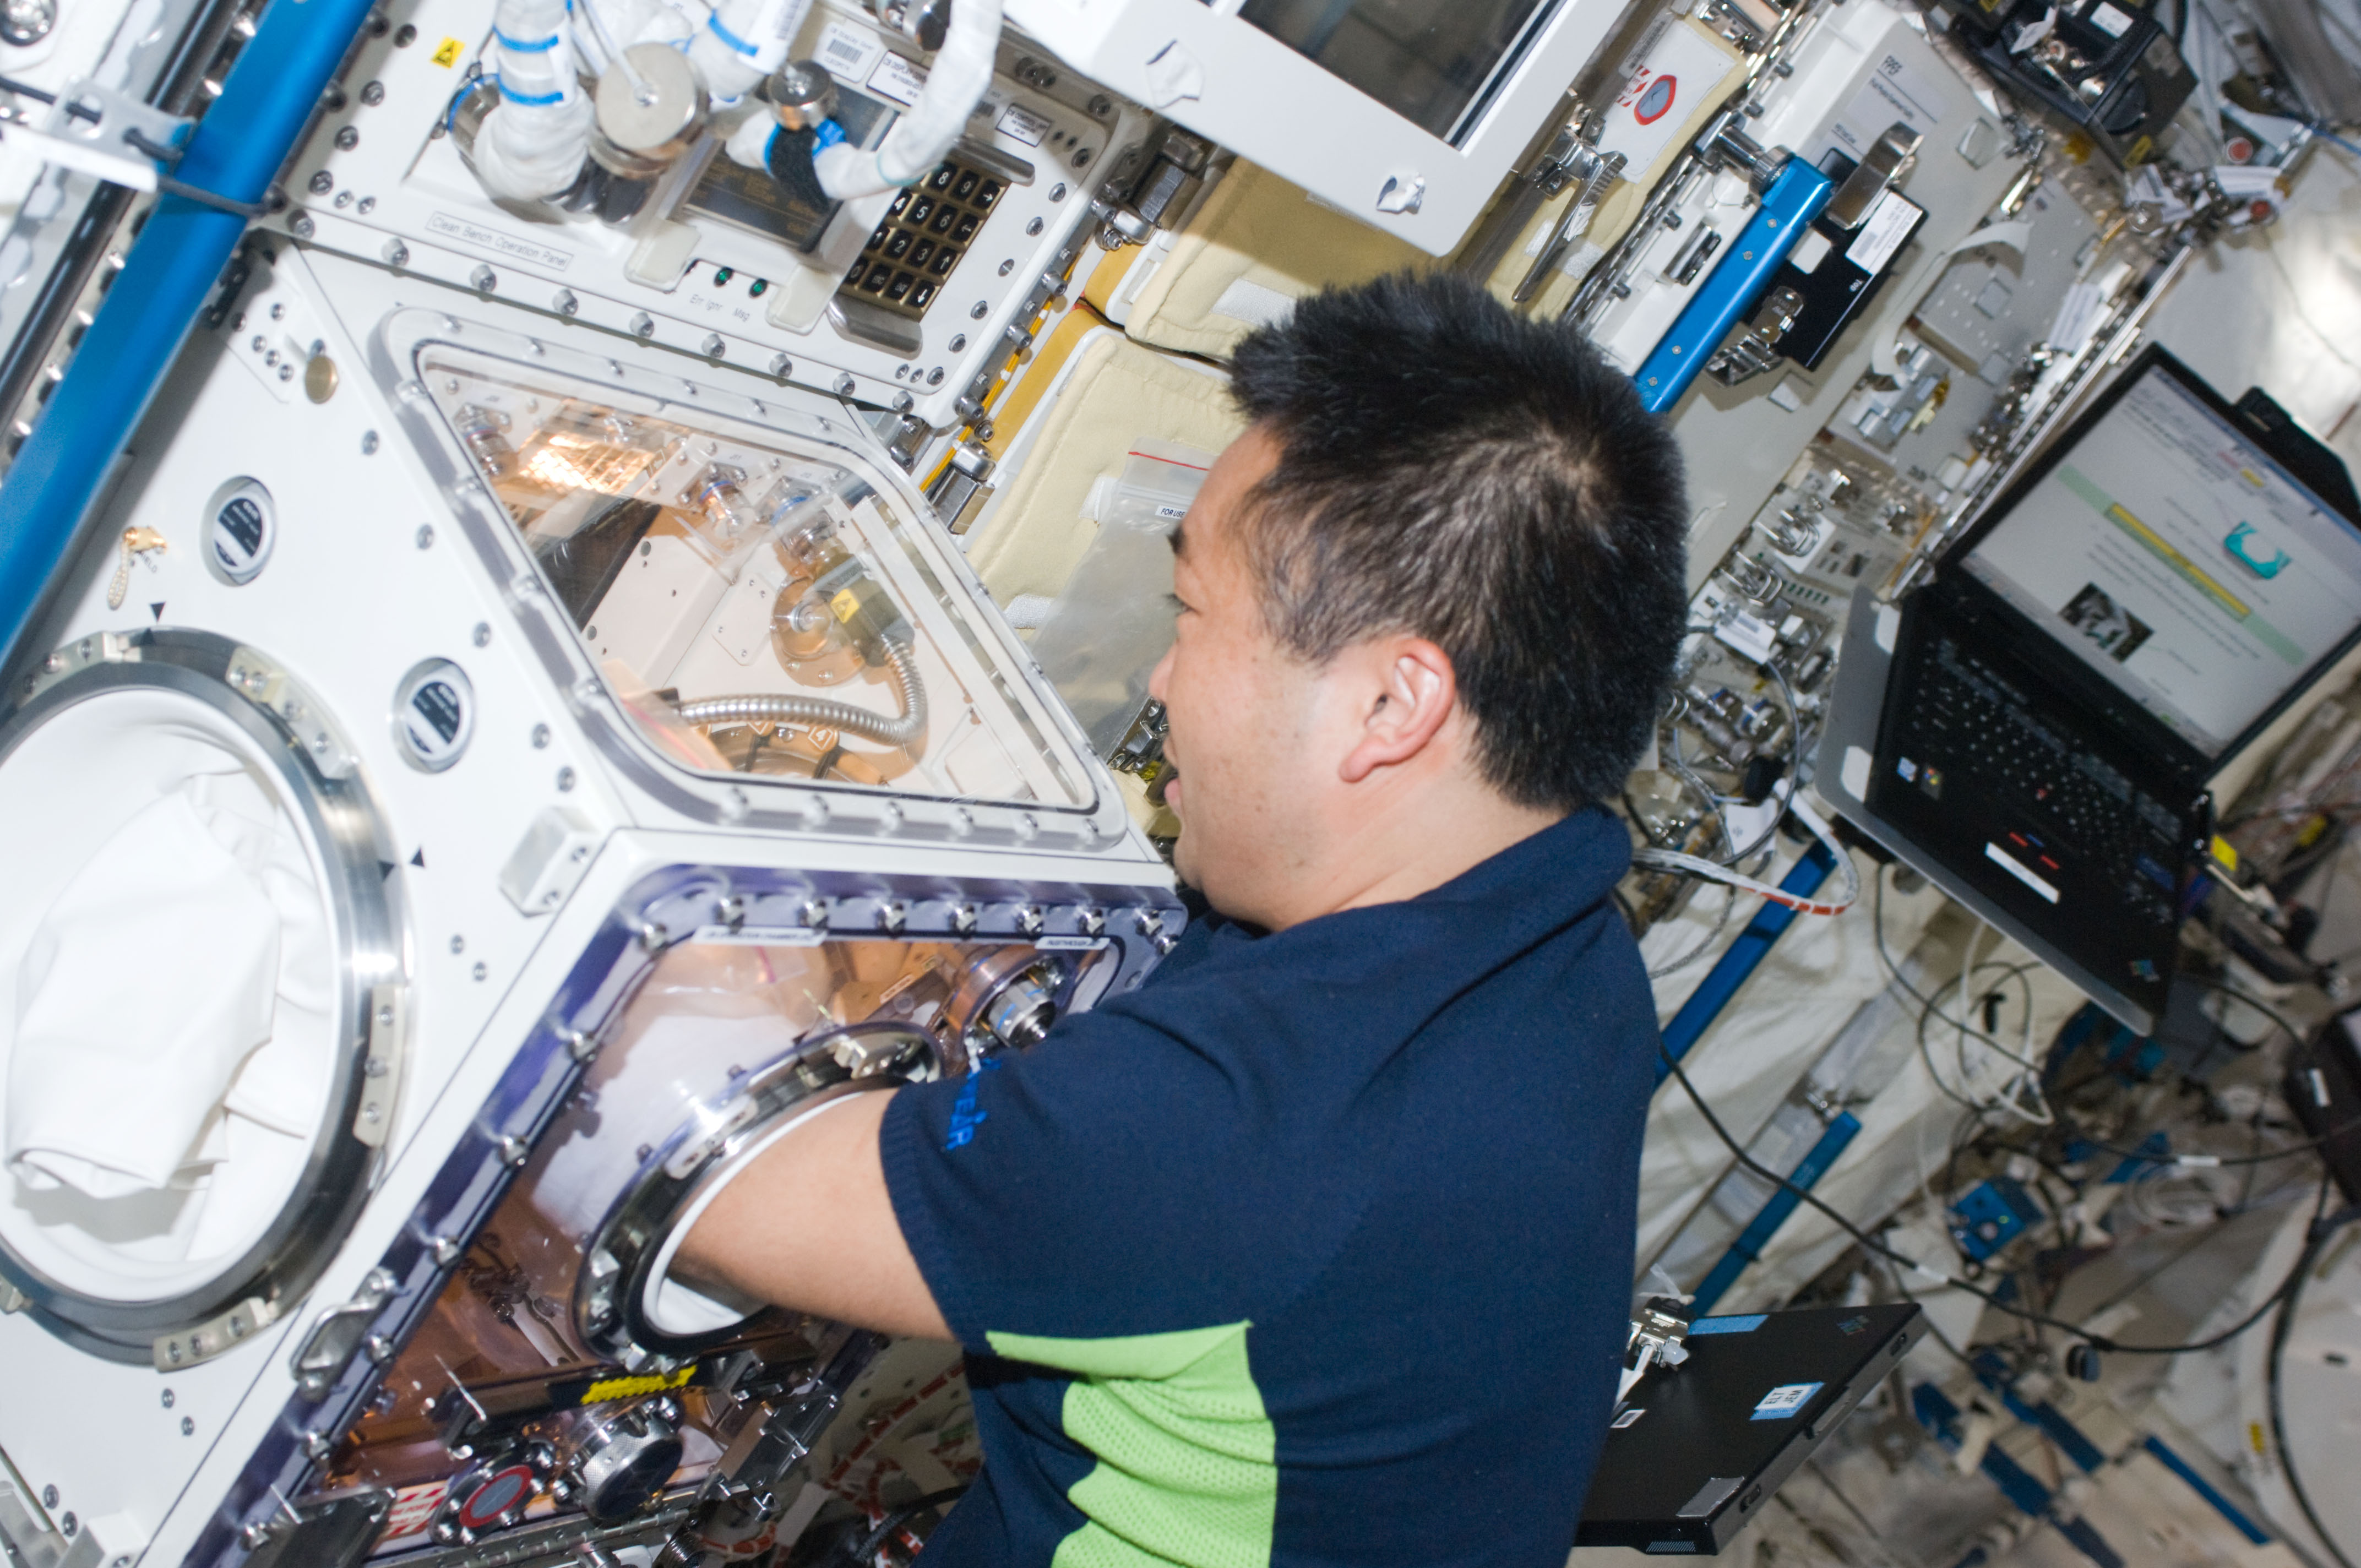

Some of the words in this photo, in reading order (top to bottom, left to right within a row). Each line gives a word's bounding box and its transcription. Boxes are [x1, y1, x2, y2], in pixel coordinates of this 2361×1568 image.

[938, 172, 949, 185] 8
[961, 181, 972, 194] 9
[894, 197, 906, 211] 4
[916, 206, 928, 220] 5
[939, 215, 950, 228] 6
[432, 217, 460, 233] Clean
[463, 226, 492, 243] Bench
[495, 237, 539, 258] Operation
[542, 251, 568, 266] Panel
[894, 239, 906, 253] 2
[917, 248, 928, 261] 3
[733, 307, 750, 322] Msg
[1764, 1392, 1785, 1404] ELT
[1783, 1390, 1804, 1404] JEM
